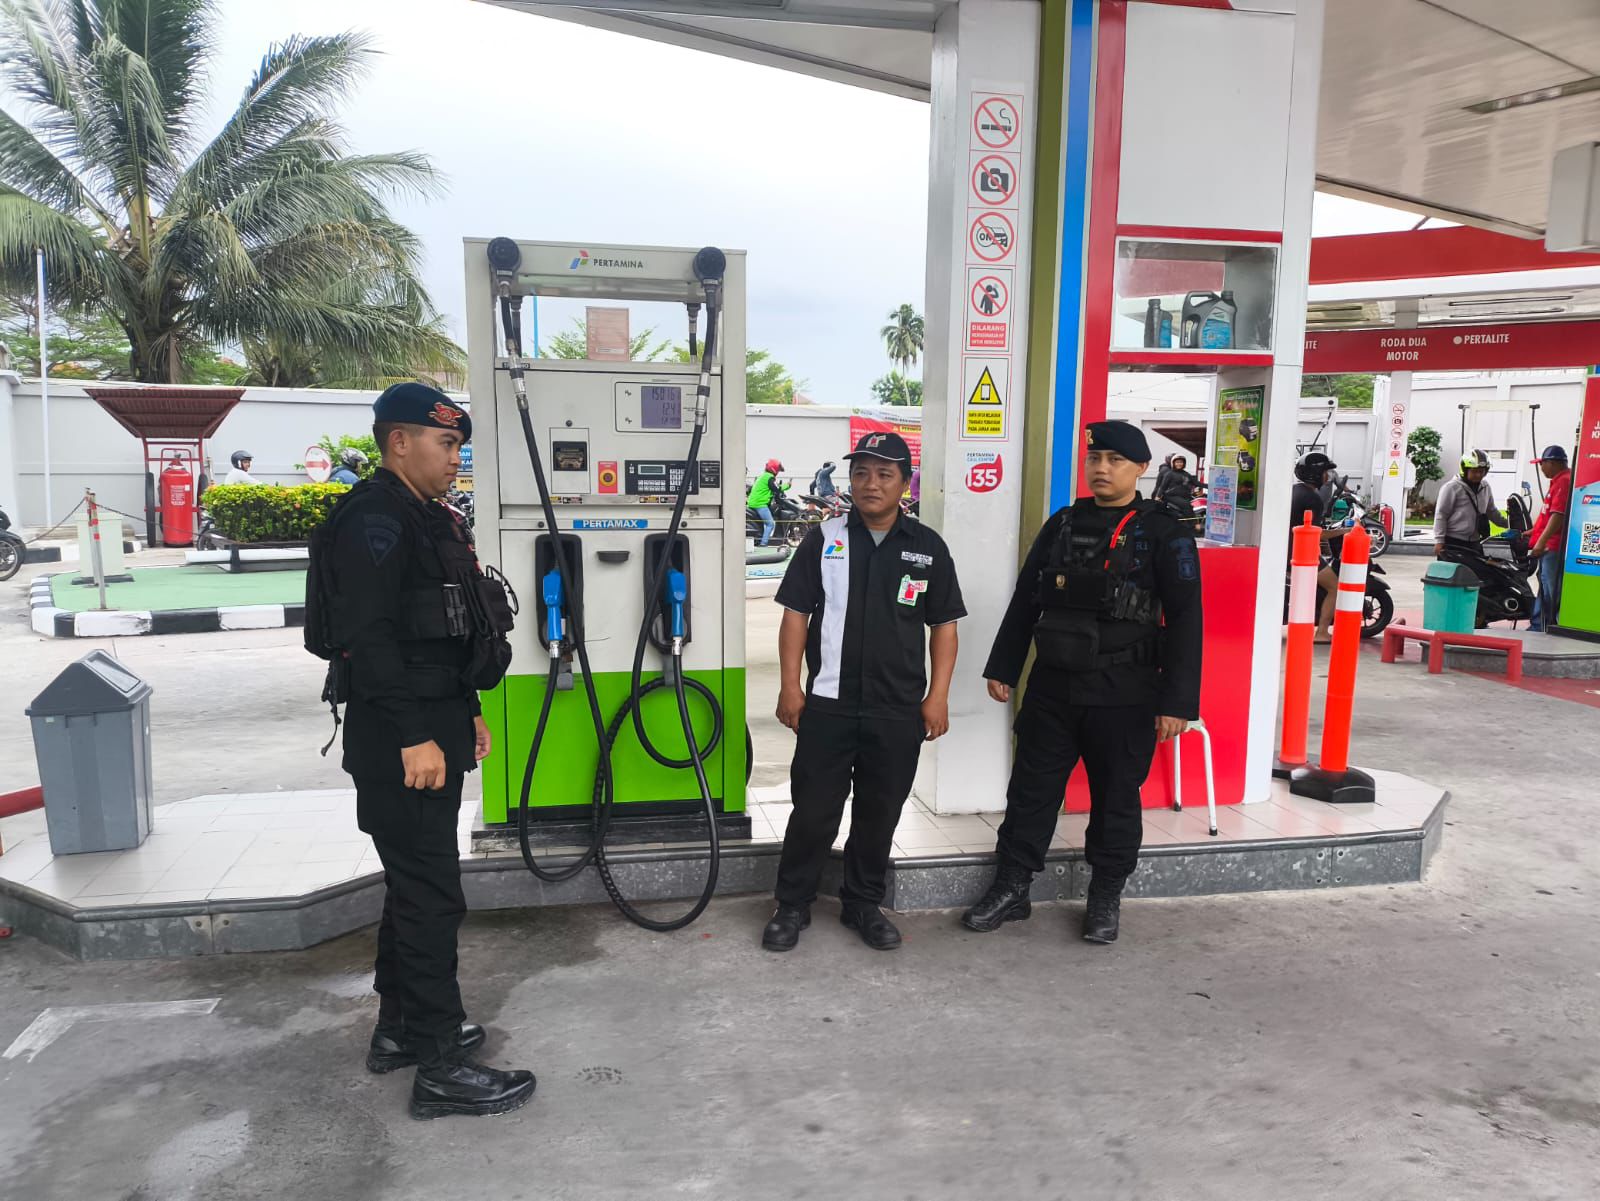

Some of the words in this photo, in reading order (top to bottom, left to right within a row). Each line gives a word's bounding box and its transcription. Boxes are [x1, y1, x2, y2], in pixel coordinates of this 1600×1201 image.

[593, 258, 644, 269] PERTAMINA
[971, 324, 1005, 332] DILARANG
[1380, 337, 1406, 348] RODA
[1408, 336, 1427, 347] DUA
[1464, 333, 1510, 345] PERTALITE
[1305, 340, 1318, 350] ITE
[1386, 351, 1419, 361] MOTOR
[967, 468, 998, 488] 135
[582, 519, 639, 529] PERTAMAX
